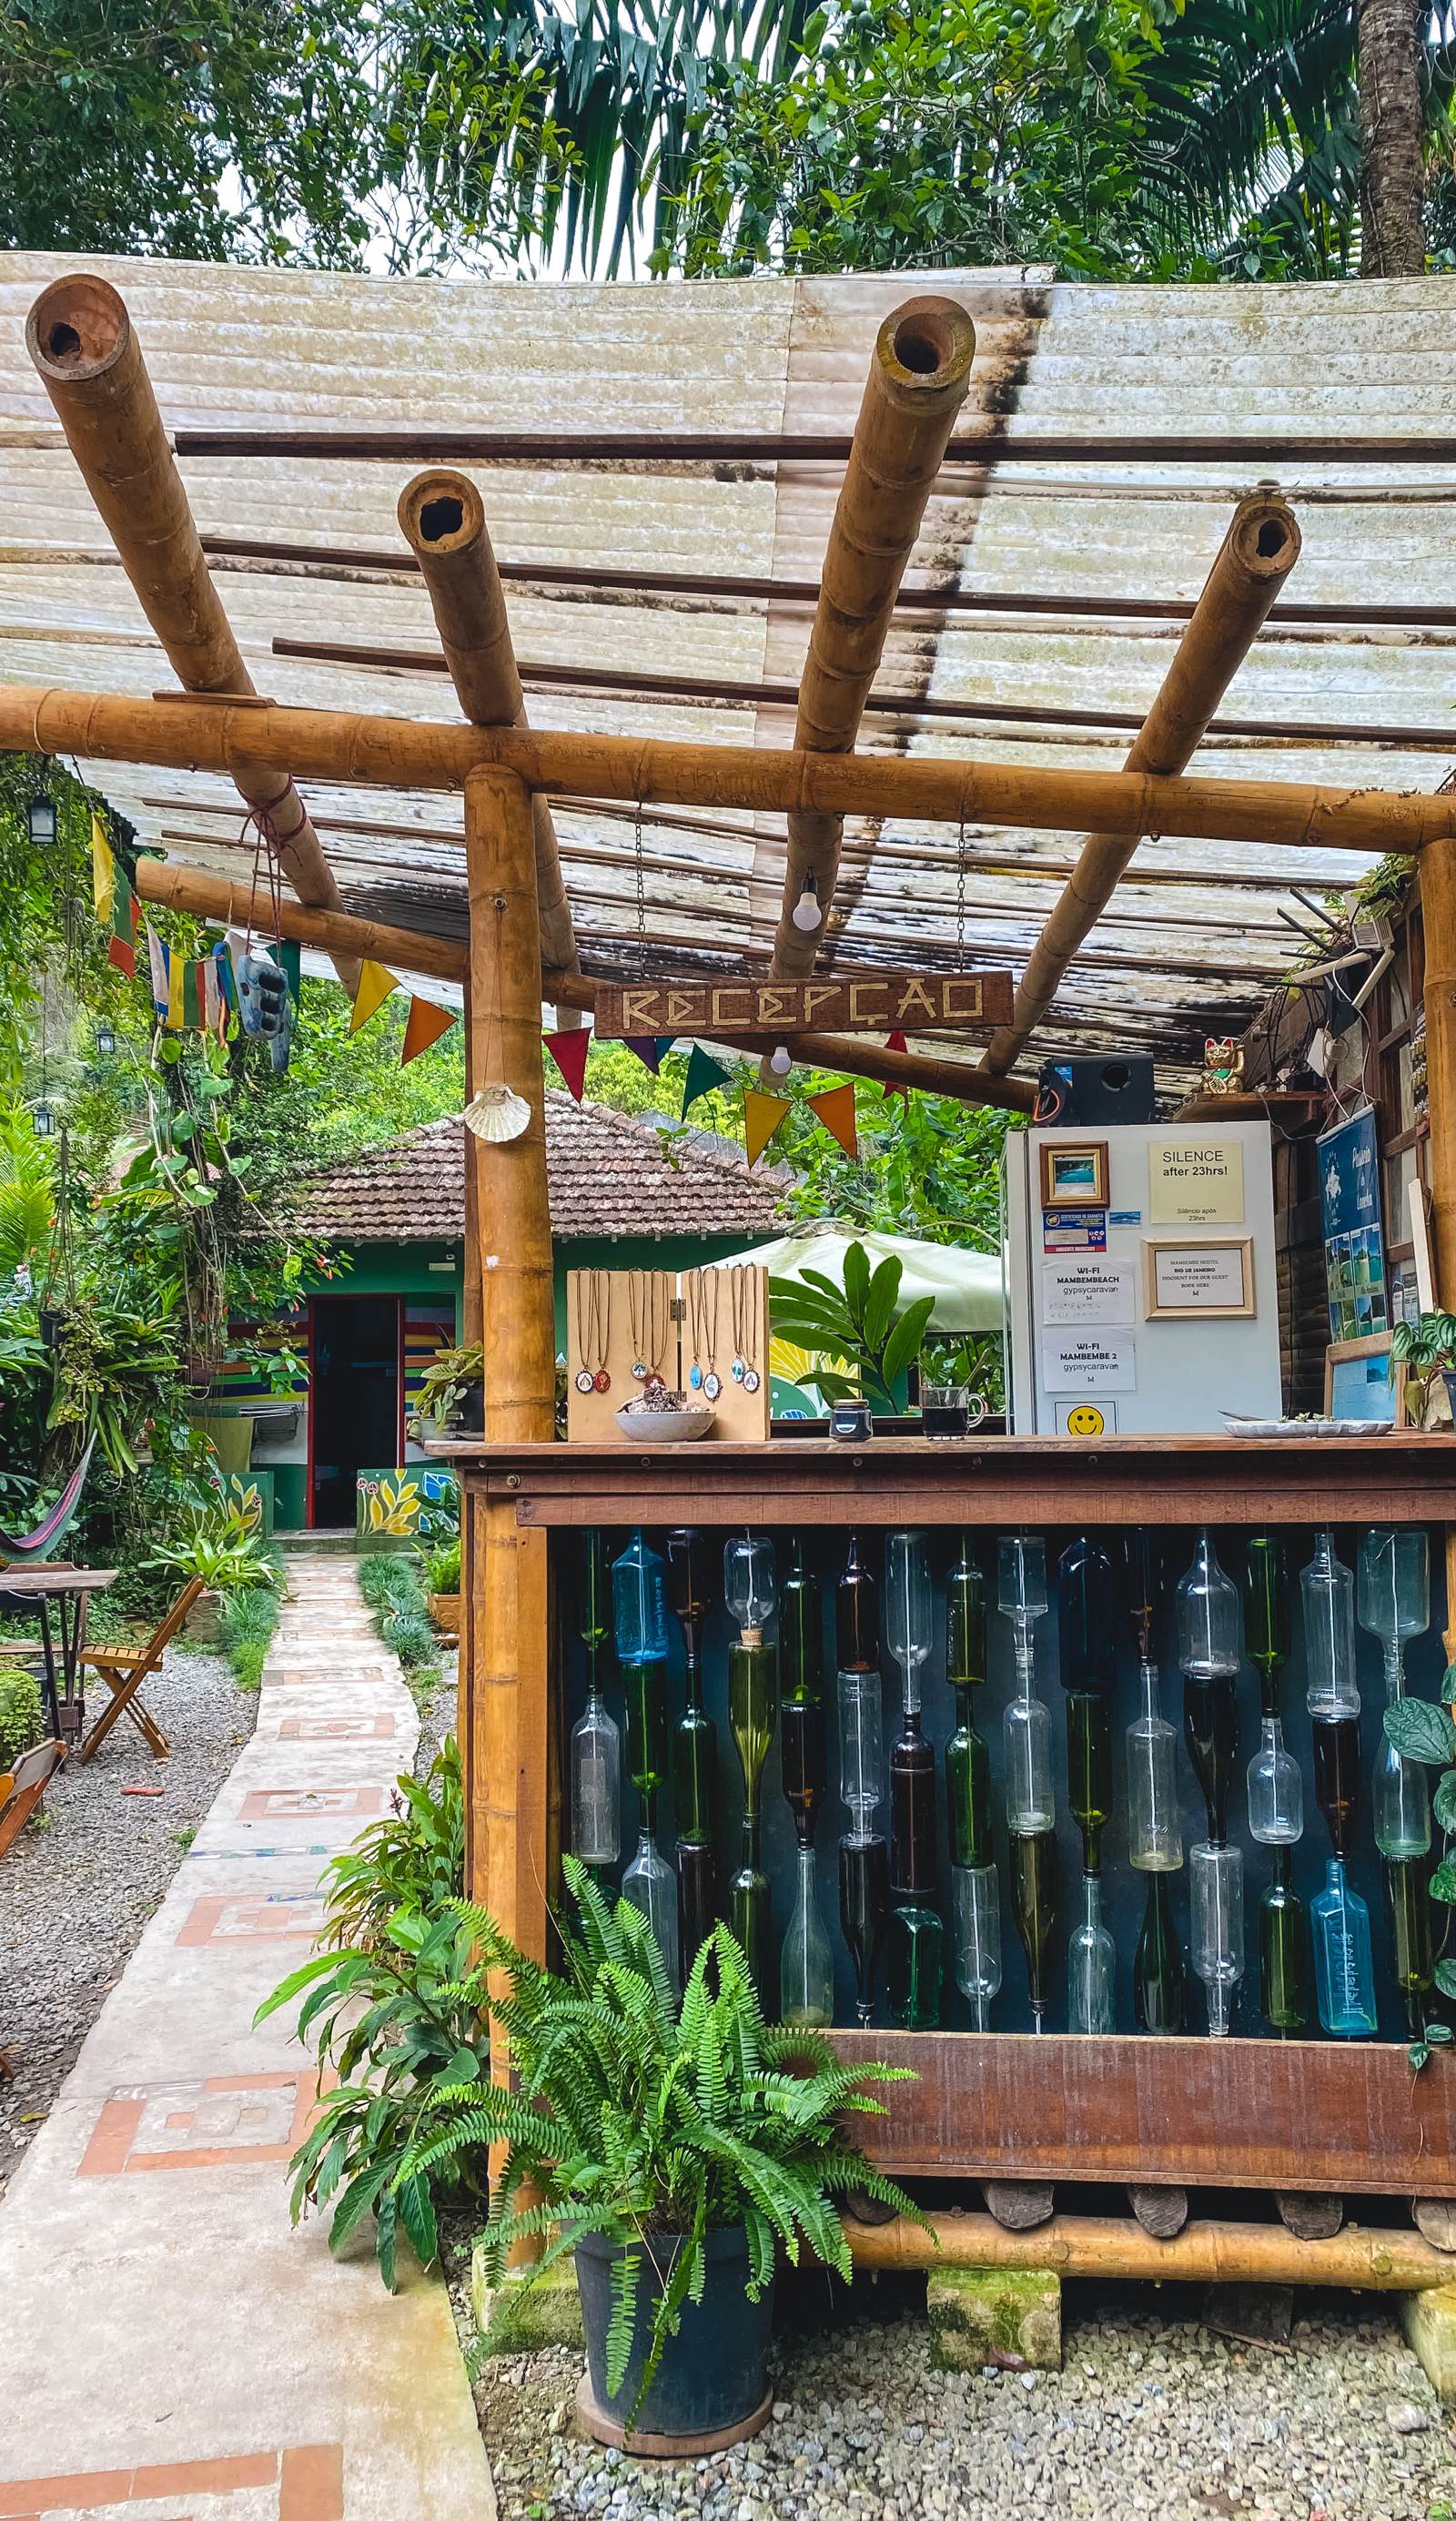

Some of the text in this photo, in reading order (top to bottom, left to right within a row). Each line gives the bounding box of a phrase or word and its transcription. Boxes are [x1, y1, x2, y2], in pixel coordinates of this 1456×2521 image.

[1163, 1150, 1223, 1162] SILENCE
[1163, 1166, 1228, 1176] after 23hrs!
[1057, 1276, 1119, 1284] MAMBEMBEACH
[1063, 1286, 1118, 1295] gypsycaravan
[1077, 1342, 1100, 1351] WI-FI
[1060, 1352, 1110, 1361] MAMBEMBE
[1063, 1363, 1119, 1372] gypsycaravan
